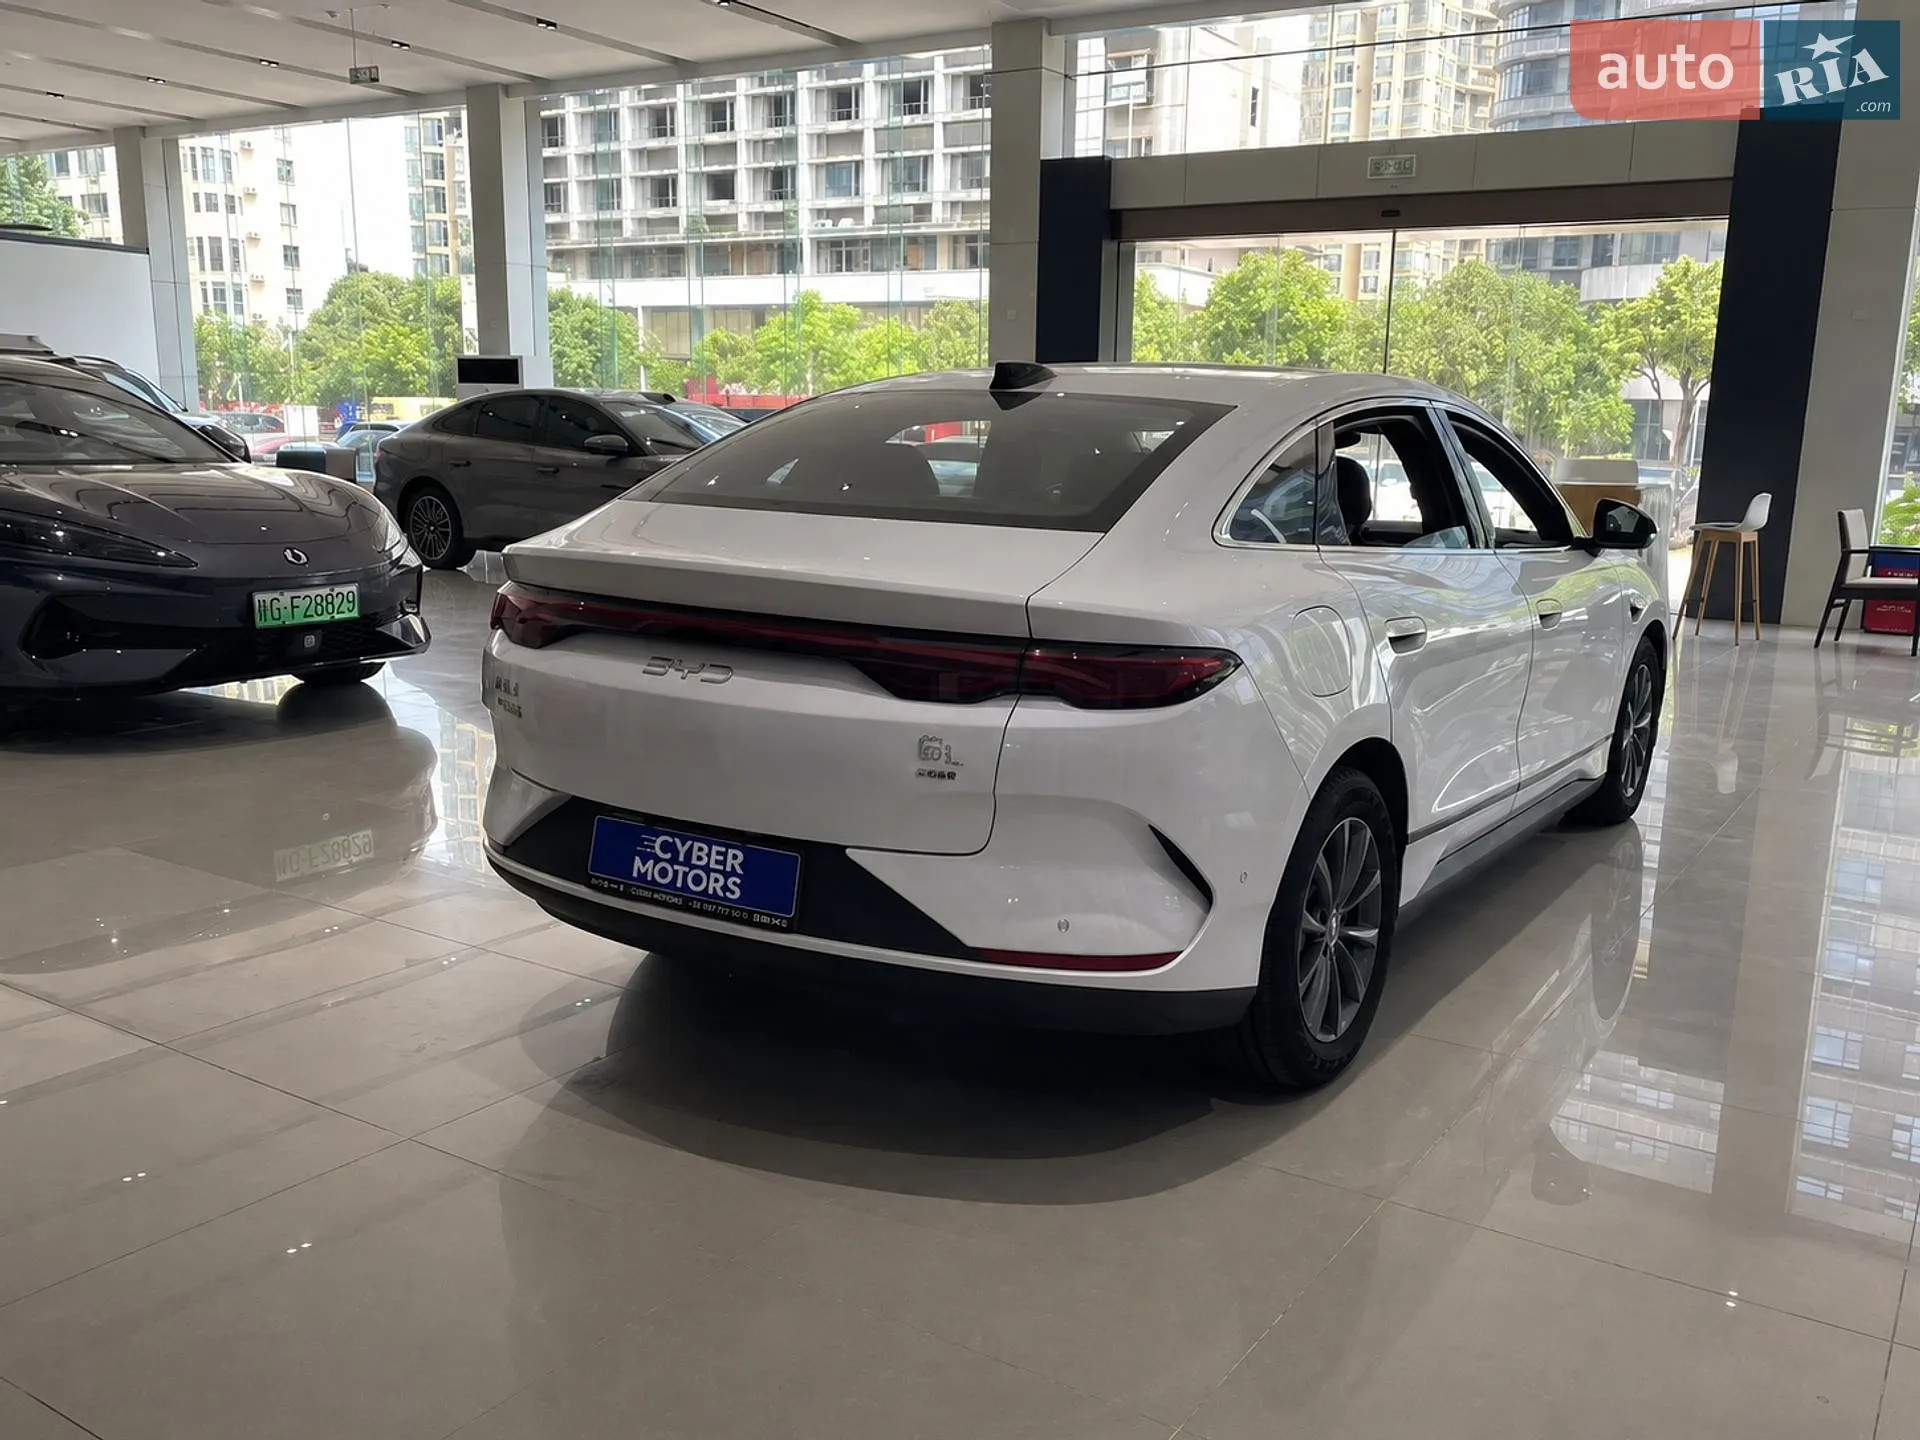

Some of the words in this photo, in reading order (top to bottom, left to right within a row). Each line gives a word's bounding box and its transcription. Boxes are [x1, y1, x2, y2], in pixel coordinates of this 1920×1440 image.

[642, 656, 734, 684] BYD
[653, 835, 745, 874] CYBER
[632, 855, 742, 900] MOTORS
